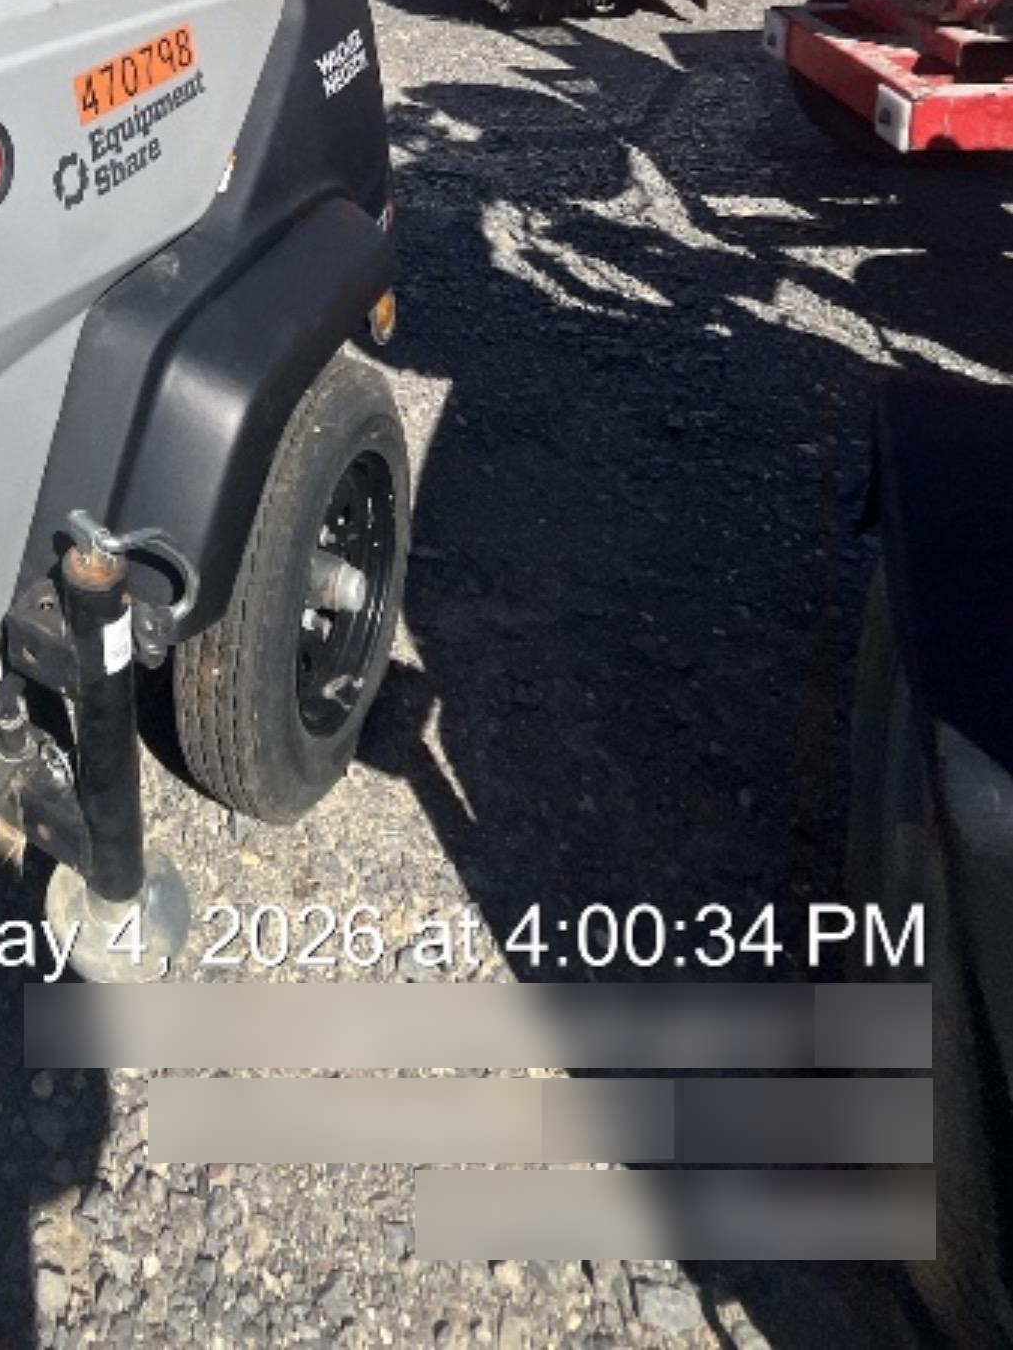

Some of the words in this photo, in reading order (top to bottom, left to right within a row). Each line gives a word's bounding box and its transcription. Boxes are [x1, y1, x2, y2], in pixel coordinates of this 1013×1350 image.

[81, 28, 194, 116] 470798
[88, 68, 206, 162] Equipment
[94, 137, 162, 196] Share
